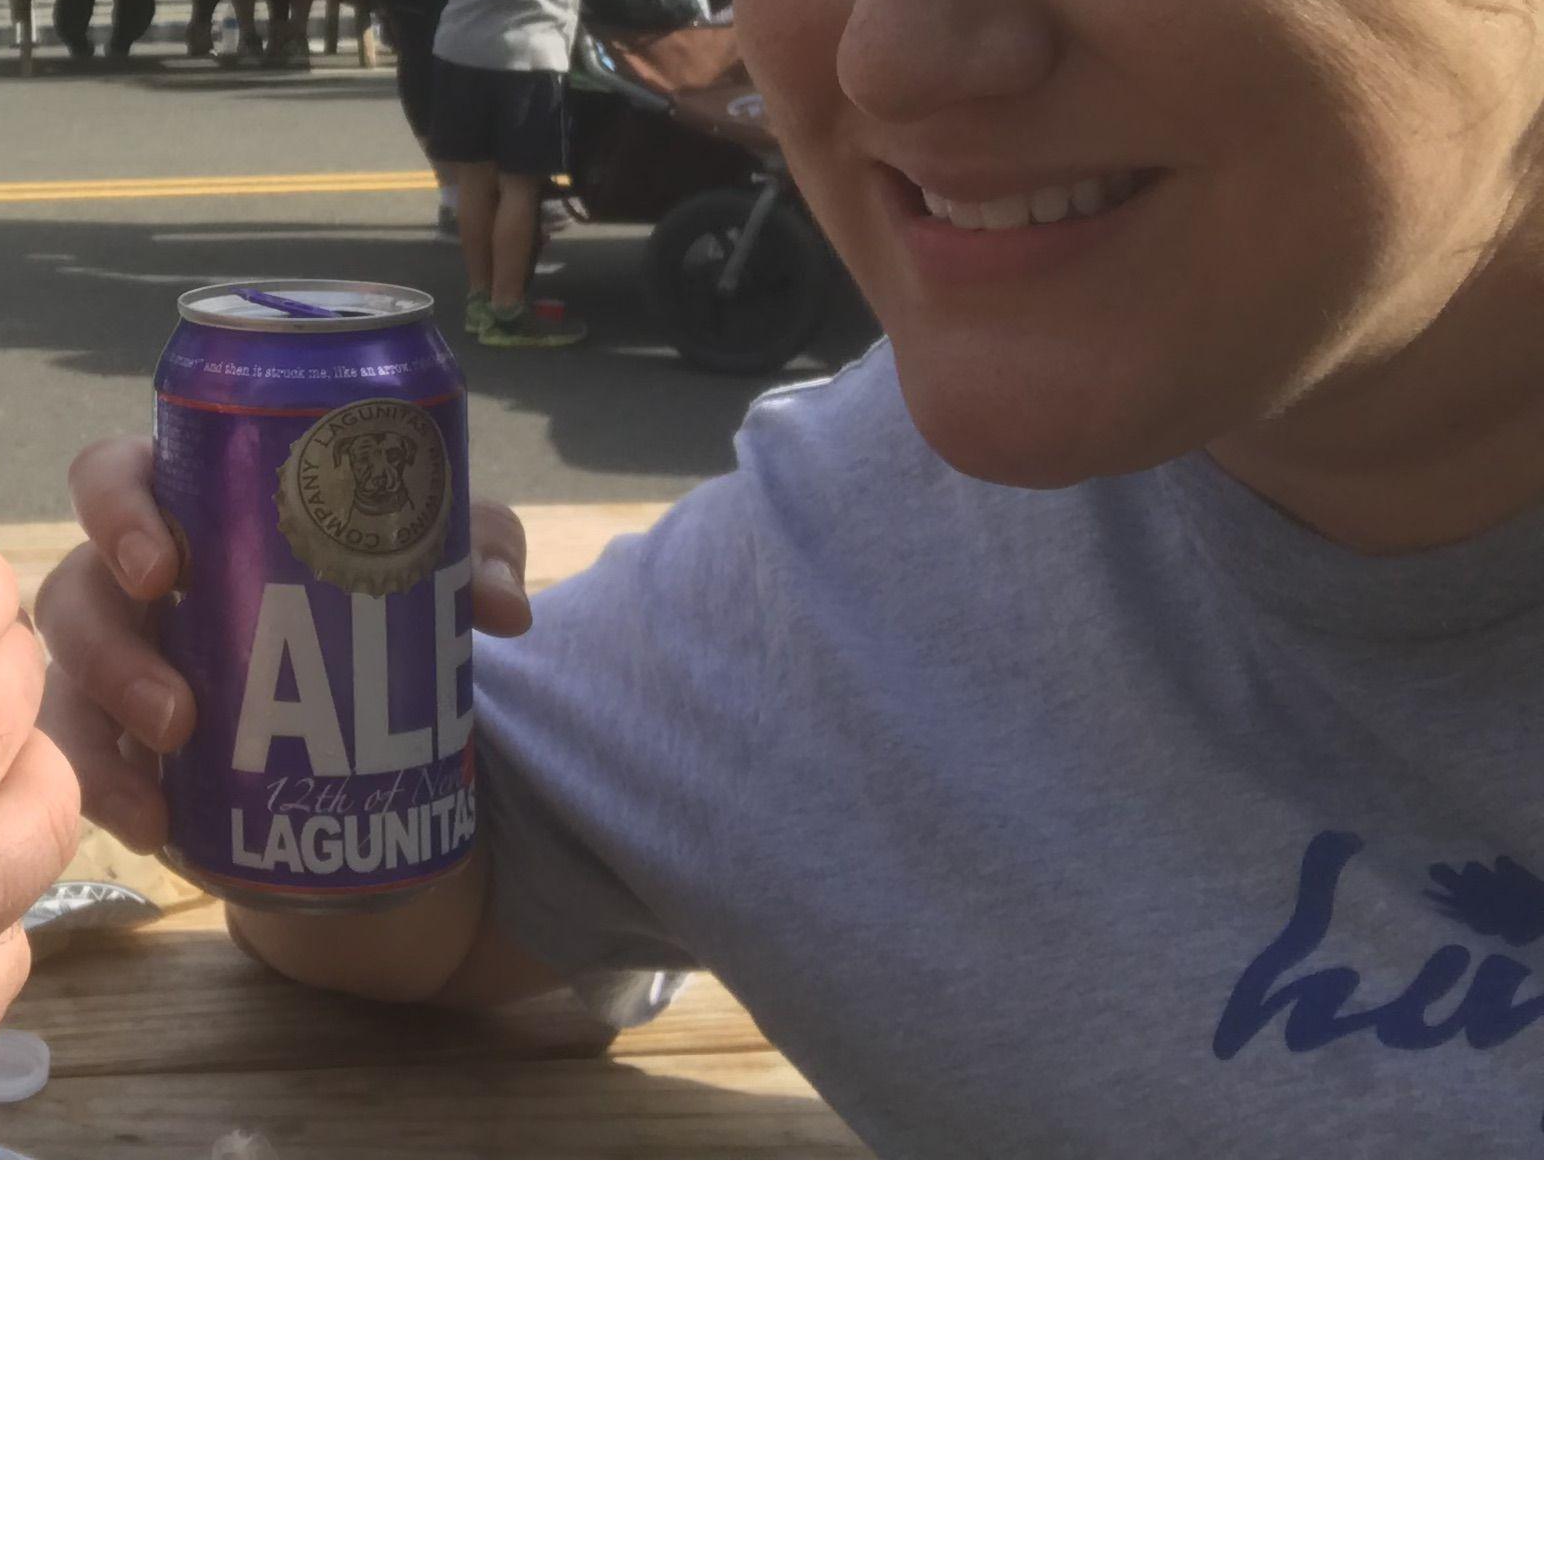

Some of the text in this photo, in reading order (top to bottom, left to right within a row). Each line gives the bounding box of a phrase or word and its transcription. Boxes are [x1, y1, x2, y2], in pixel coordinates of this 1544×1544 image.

[225, 363, 249, 376] then
[253, 364, 262, 377] it
[265, 366, 305, 379] struck
[334, 365, 357, 379] like
[360, 365, 376, 377] an
[314, 406, 429, 451] LAGUNITAS
[302, 469, 379, 548] COMPANY
[231, 559, 473, 778] ALE
